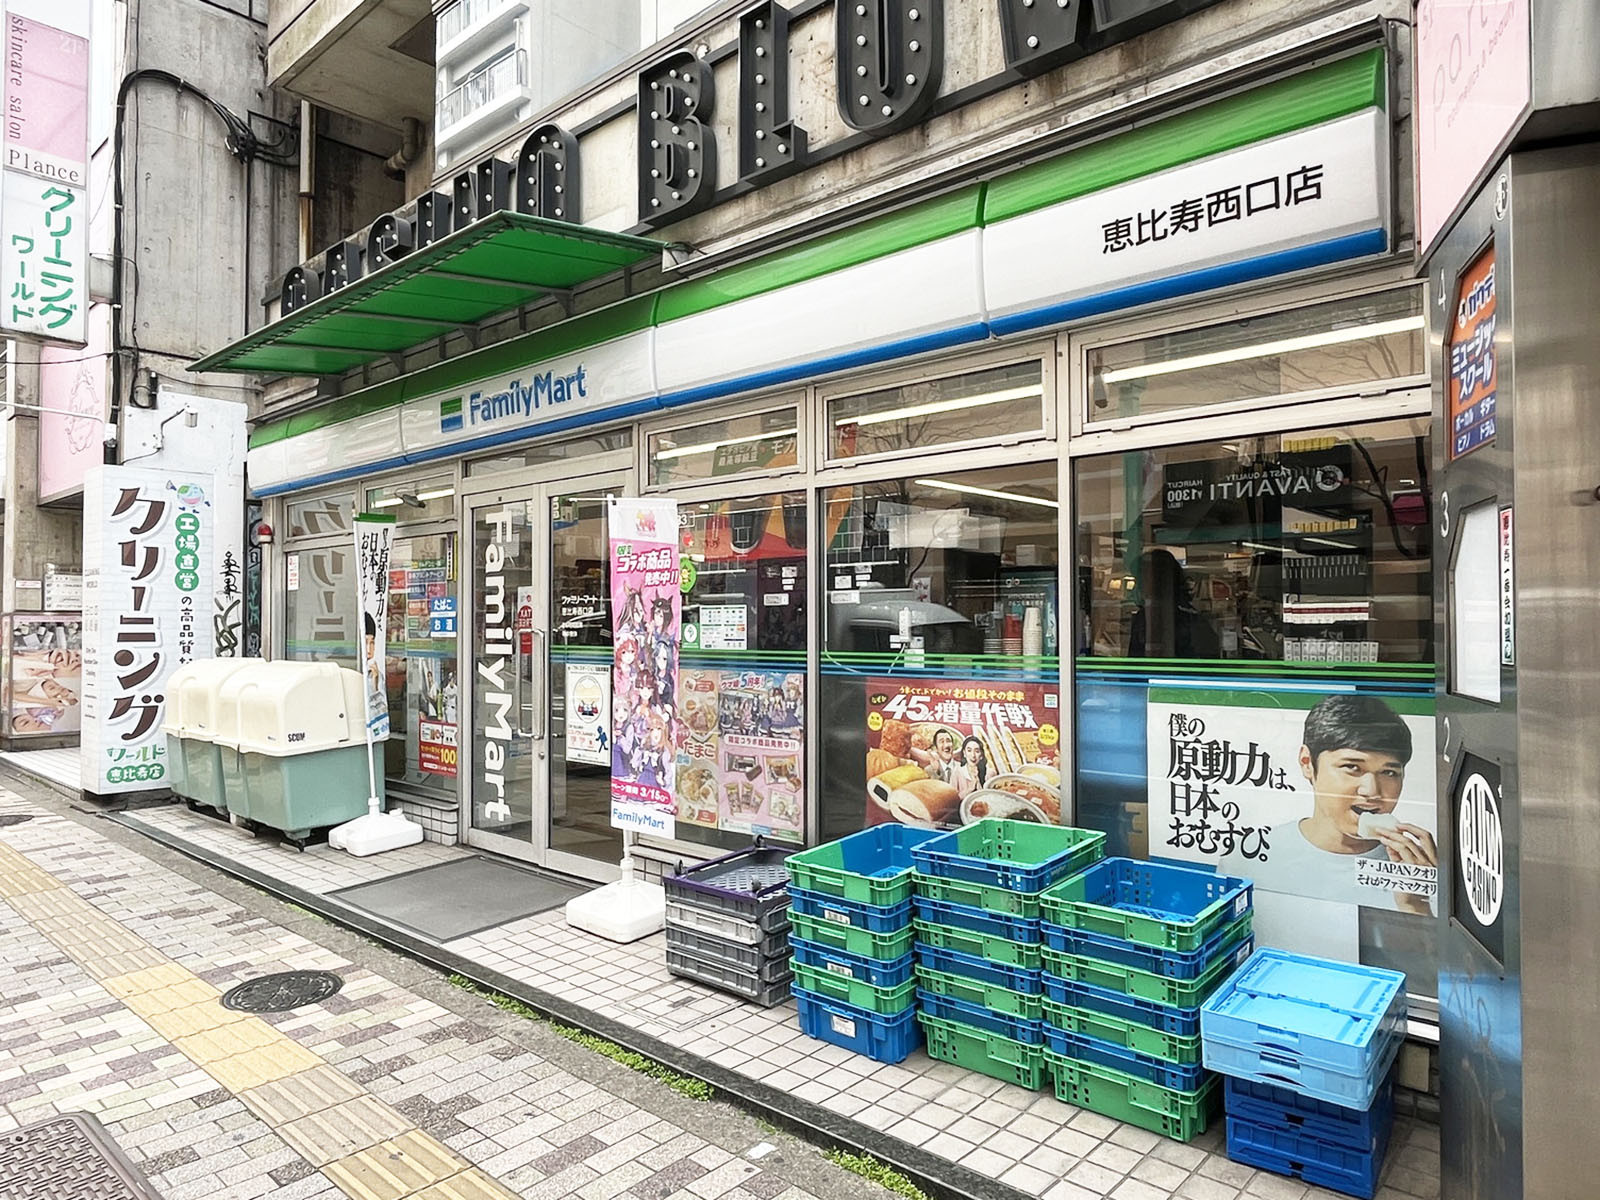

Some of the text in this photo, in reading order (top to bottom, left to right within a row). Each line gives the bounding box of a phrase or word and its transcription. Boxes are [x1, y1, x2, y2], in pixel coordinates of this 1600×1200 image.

[9, 16, 28, 140] skincare salon
[9, 149, 80, 182] Plance
[1102, 164, 1324, 255] 恵比寿西口店
[11, 234, 35, 323] ワールド
[39, 187, 77, 329] クリーニング
[1438, 266, 1447, 312] 4
[469, 363, 587, 425] FamilyMart
[1459, 351, 1493, 400] スクール
[1440, 491, 1450, 538] 3
[109, 487, 165, 741] クリーニング
[433, 599, 453, 611] たばこ
[478, 511, 514, 822] FamilyMart
[1168, 713, 1206, 737] 僕の
[106, 744, 166, 762] ワールド
[110, 765, 162, 781] 恵比寿店
[1167, 738, 1297, 792] 原動力は、
[613, 808, 665, 829] FamilyMart
[1169, 781, 1241, 821] 日本の
[1166, 817, 1272, 862] おむすび。
